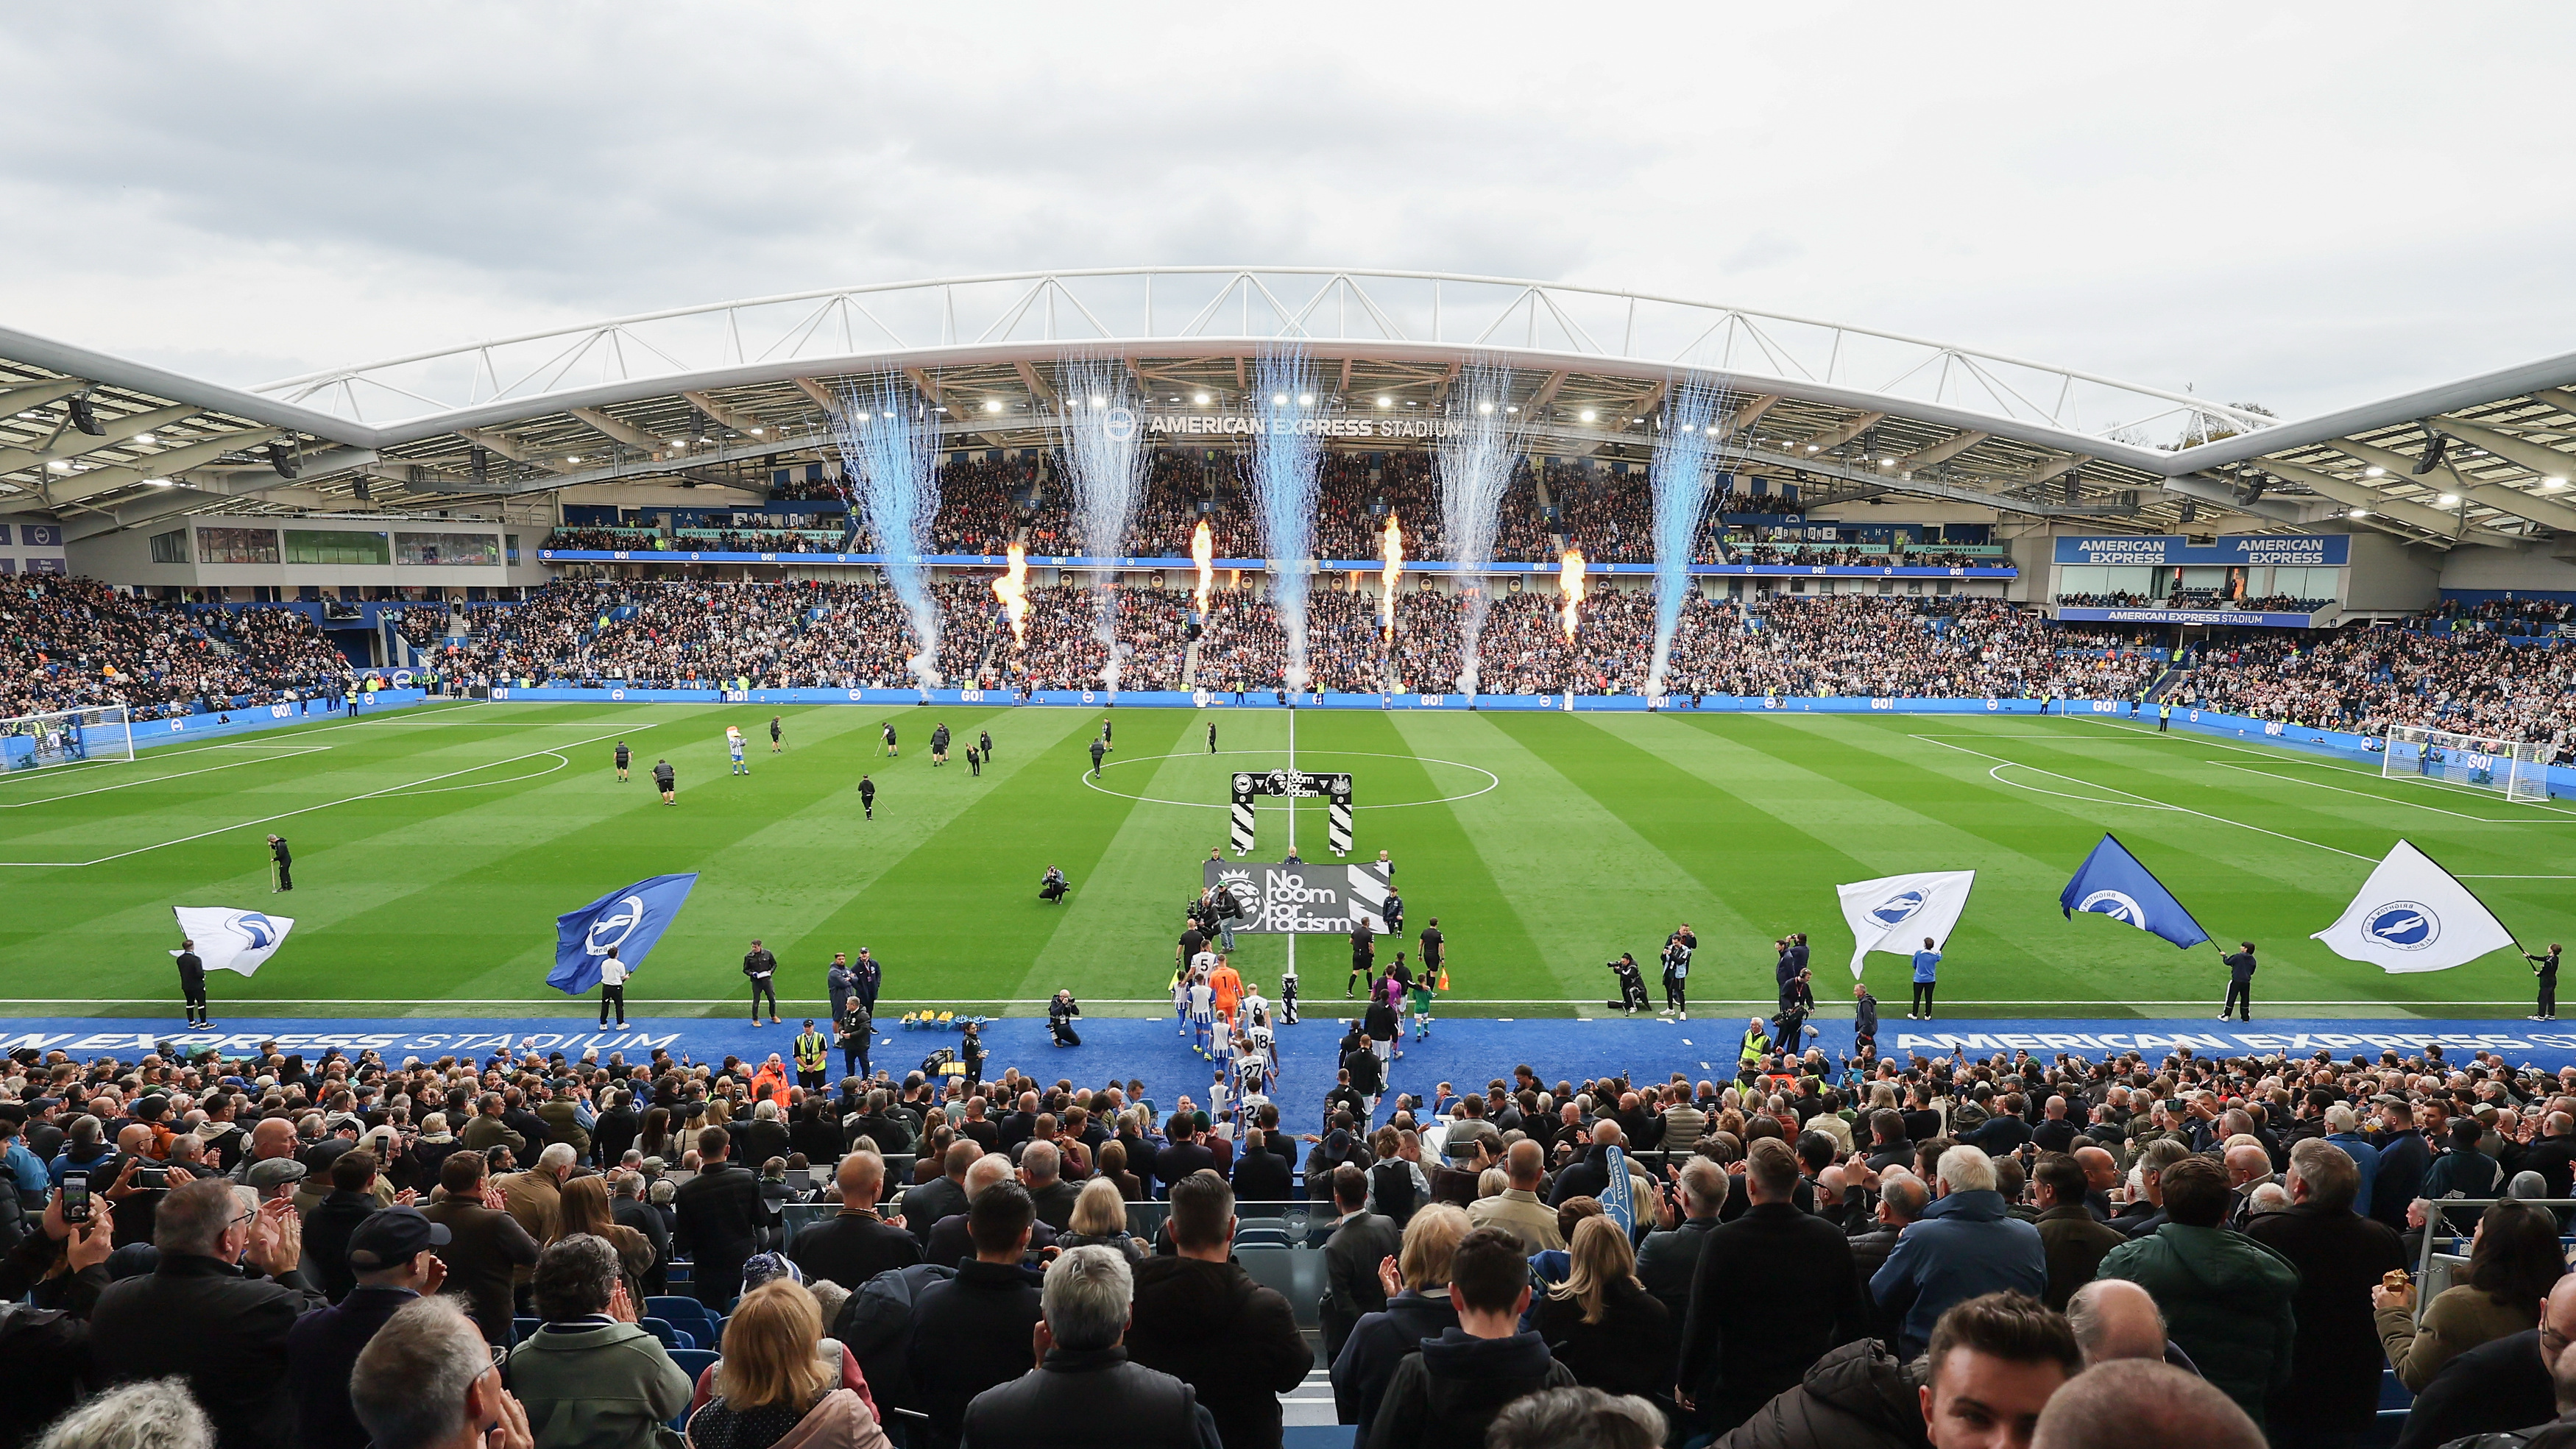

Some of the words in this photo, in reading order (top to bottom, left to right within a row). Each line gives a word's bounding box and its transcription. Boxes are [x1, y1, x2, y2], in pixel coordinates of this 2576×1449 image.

[1150, 417, 1265, 434] AMERICAN
[1272, 418, 1373, 436] EXPRESS
[1381, 420, 1463, 438] STADIUM
[1376, 505, 1381, 513] E
[2078, 540, 2165, 552] AMERICAN
[2236, 539, 2324, 551] AMERICAN
[614, 551, 629, 559] GO!
[2090, 553, 2165, 564] EXPRESS
[2248, 552, 2324, 564] EXPRESS
[1533, 563, 1547, 571] GO!
[817, 609, 824, 617] B
[2108, 612, 2167, 620] AMERICAN
[2168, 613, 2220, 623] EXPRESS
[2221, 614, 2262, 624] STADIUM
[492, 687, 509, 699] O!
[726, 690, 749, 701] GO!
[961, 690, 984, 702] GO!
[1420, 694, 1444, 706] GO!
[1647, 696, 1669, 708] GO!
[1871, 698, 1894, 709] GO!
[271, 704, 293, 719] GO!
[2092, 701, 2117, 712] GO!
[2265, 722, 2283, 736] GO!
[2467, 754, 2494, 772] GO!
[1288, 768, 1303, 777] No
[1287, 787, 1319, 798] racism
[1266, 869, 1304, 889] No
[1266, 886, 1337, 904] room
[1264, 901, 1303, 920] for
[1266, 912, 1351, 931] racism
[1200, 959, 1209, 971] 5
[1222, 976, 1227, 988] 1
[1253, 1002, 1262, 1016] 6
[62, 1033, 410, 1049] EXPRESS
[403, 1033, 682, 1049] STADIUM
[1254, 1034, 1268, 1049] 18
[1897, 1034, 2234, 1049] AMERICAN
[2230, 1034, 2535, 1049] EXPRESS
[1244, 1063, 1262, 1080] 27
[1610, 1151, 1618, 1164] THE
[1613, 1165, 1624, 1201] SEAGULLS
